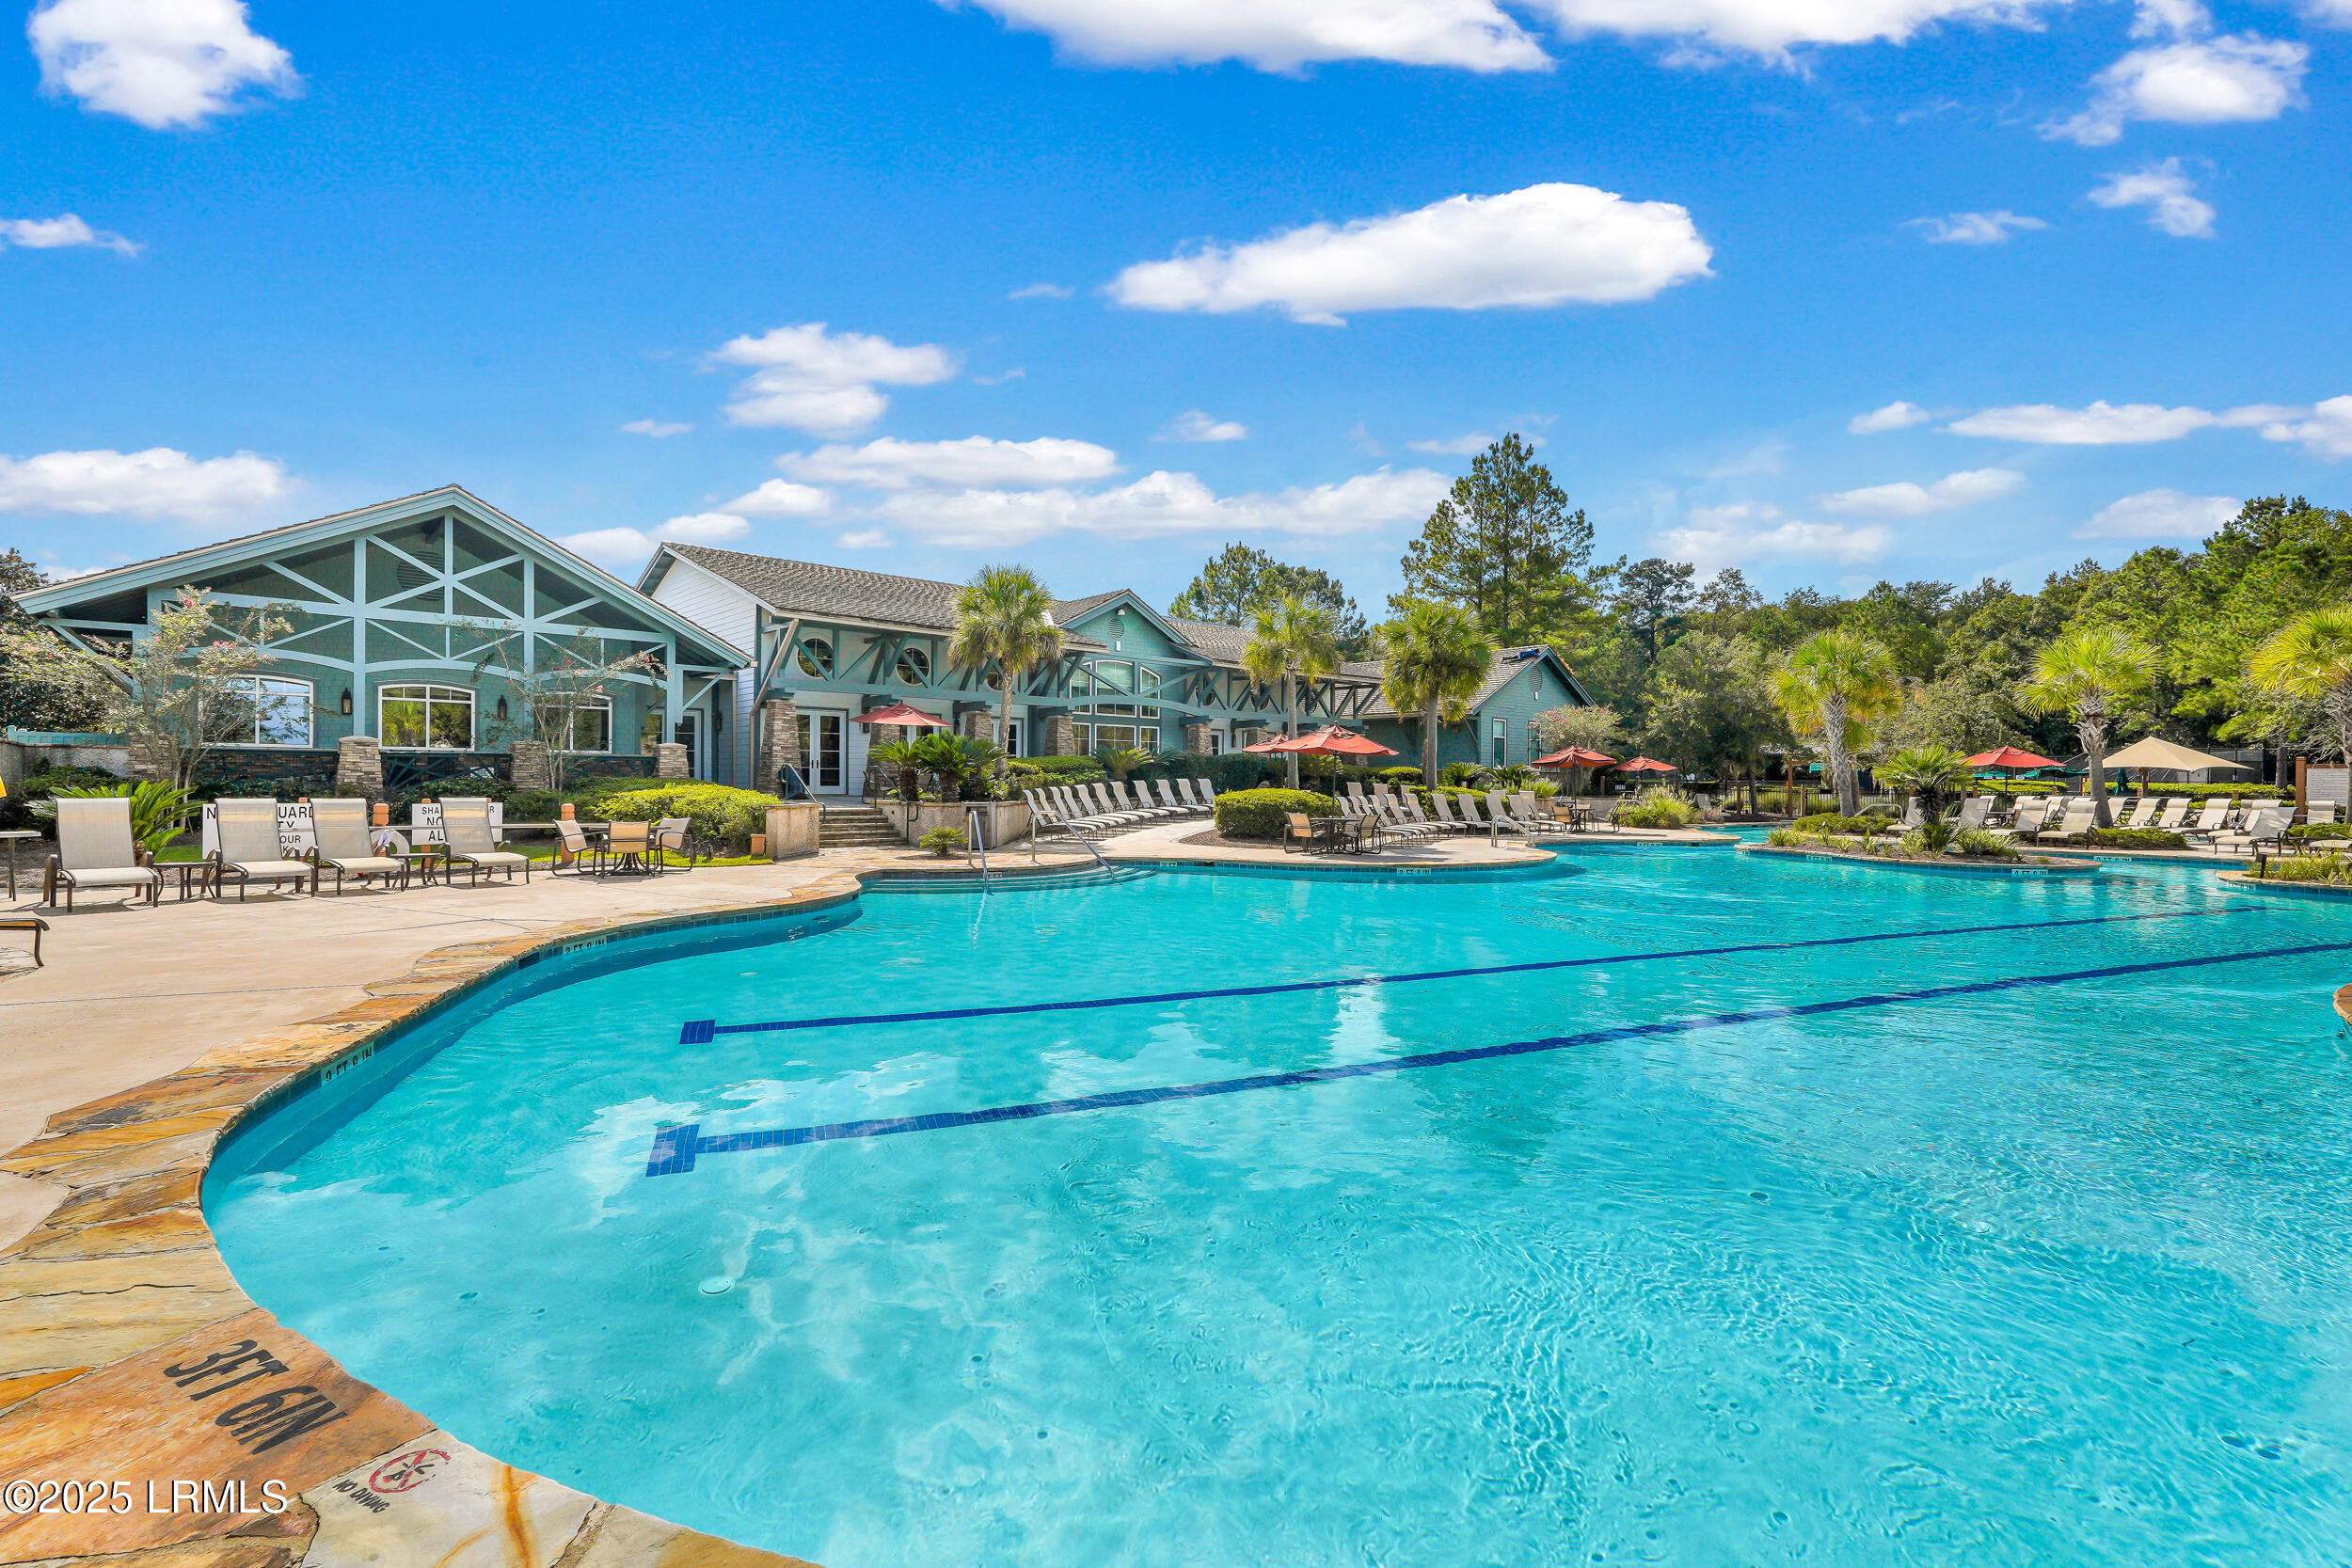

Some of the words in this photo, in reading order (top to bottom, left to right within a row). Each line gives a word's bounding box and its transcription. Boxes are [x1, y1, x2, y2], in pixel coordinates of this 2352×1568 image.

[422, 806, 440, 815] SHA
[279, 834, 301, 844] OUR
[428, 830, 444, 842] AL
[332, 1479, 358, 1493] NO
[349, 1487, 390, 1513] DIVING
